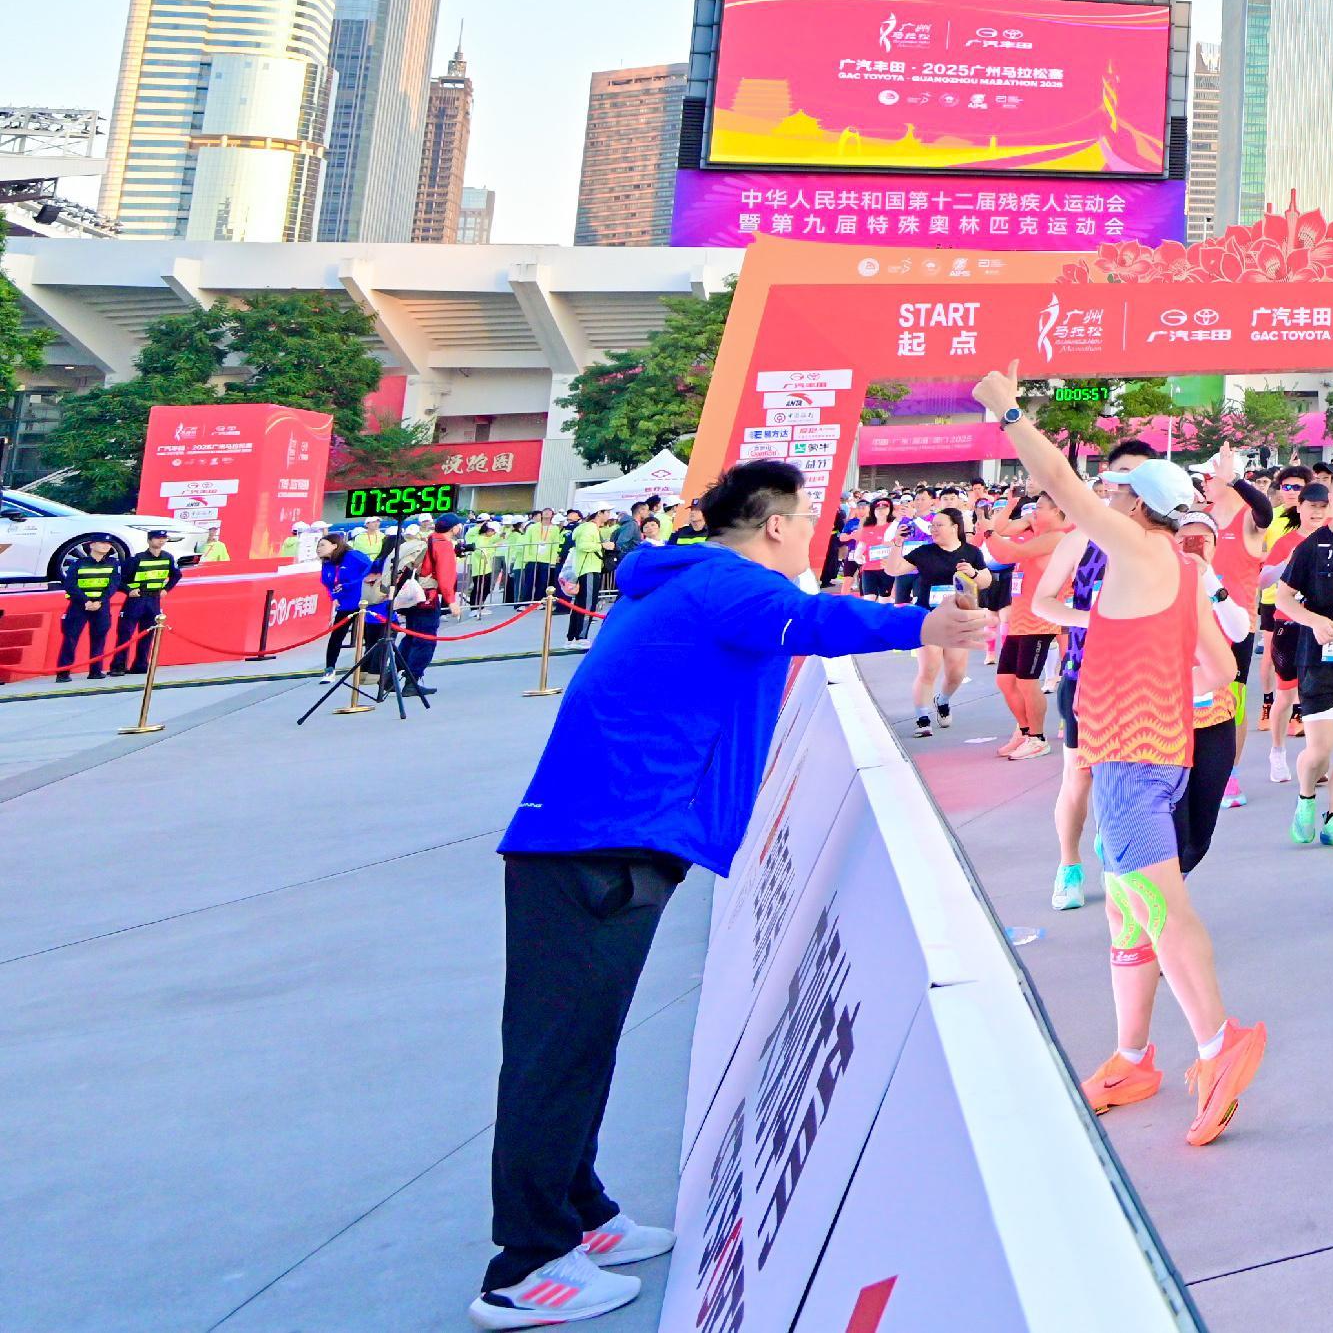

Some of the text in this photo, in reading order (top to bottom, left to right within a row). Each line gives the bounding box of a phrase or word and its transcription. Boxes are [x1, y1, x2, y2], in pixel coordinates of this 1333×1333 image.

[965, 39, 1033, 49] 广汽丰田
[839, 58, 906, 74] 广汽丰田
[838, 72, 862, 80] GAC
[863, 73, 905, 82] TOYOTA
[912, 75, 979, 85] GUANGZHOU
[980, 77, 1038, 88] MARATHON
[740, 189, 1127, 215] 中华人民共和国第十二届残疾人运动会
[738, 213, 1125, 236] 暨第九届特殊奥林匹克运动会
[899, 302, 981, 327] START
[1063, 309, 1105, 325] 广州
[1251, 306, 1332, 327] 广汽丰田
[1053, 325, 1104, 338] 马拉松
[1146, 329, 1232, 343] 广汽丰田
[1250, 331, 1279, 341] GAC
[1280, 330, 1331, 341] TOYOTA
[897, 330, 978, 356] 起点
[1055, 387, 1110, 402] 00:05:57
[350, 484, 452, 516] 07:25:56
